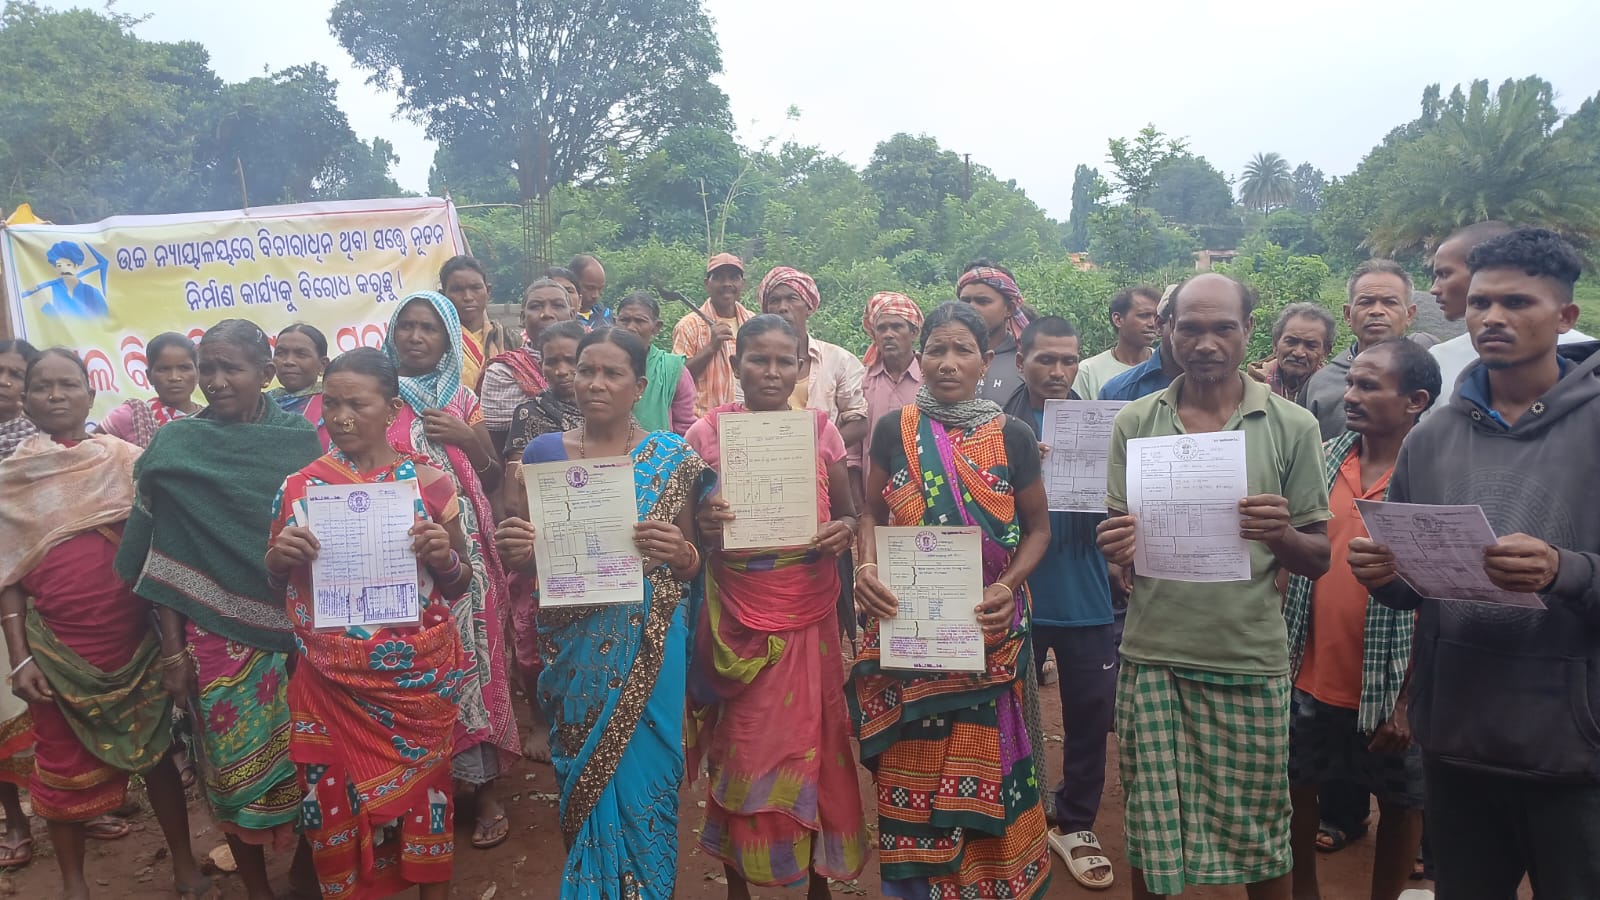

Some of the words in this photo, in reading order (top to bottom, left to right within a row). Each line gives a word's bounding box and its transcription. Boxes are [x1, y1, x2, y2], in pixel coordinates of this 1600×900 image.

[410, 223, 444, 256] ନୂତନ
[185, 279, 235, 311] ନିର୍ମାଣ
[298, 271, 352, 300] ବିରୋଧ
